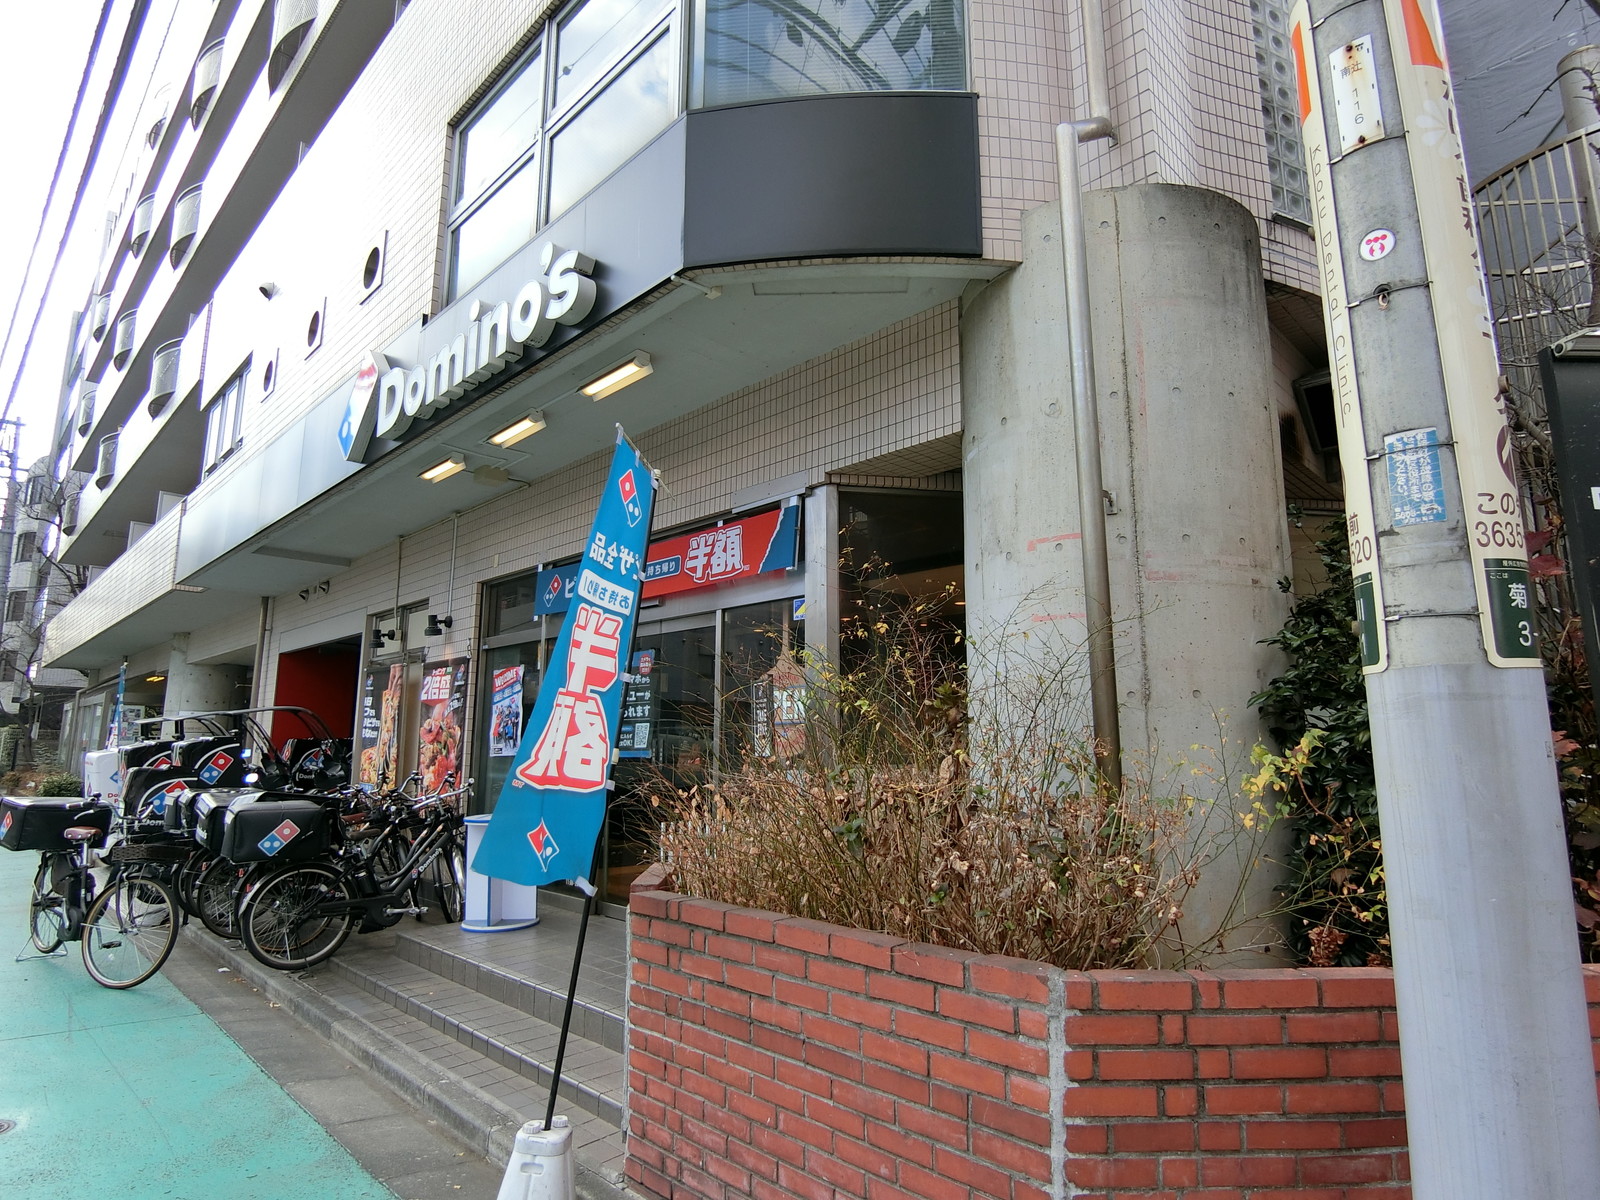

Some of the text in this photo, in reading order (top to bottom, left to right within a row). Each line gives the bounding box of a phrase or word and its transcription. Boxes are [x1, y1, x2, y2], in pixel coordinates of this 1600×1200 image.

[1352, 87, 1365, 125] 116
[1309, 144, 1352, 415] Kaoru Dental Clinic
[376, 241, 597, 440] Domino's
[646, 560, 676, 578] 持ち帰り
[684, 525, 744, 582] 半額
[630, 674, 651, 684] マホから
[418, 847, 443, 873] Domino's
